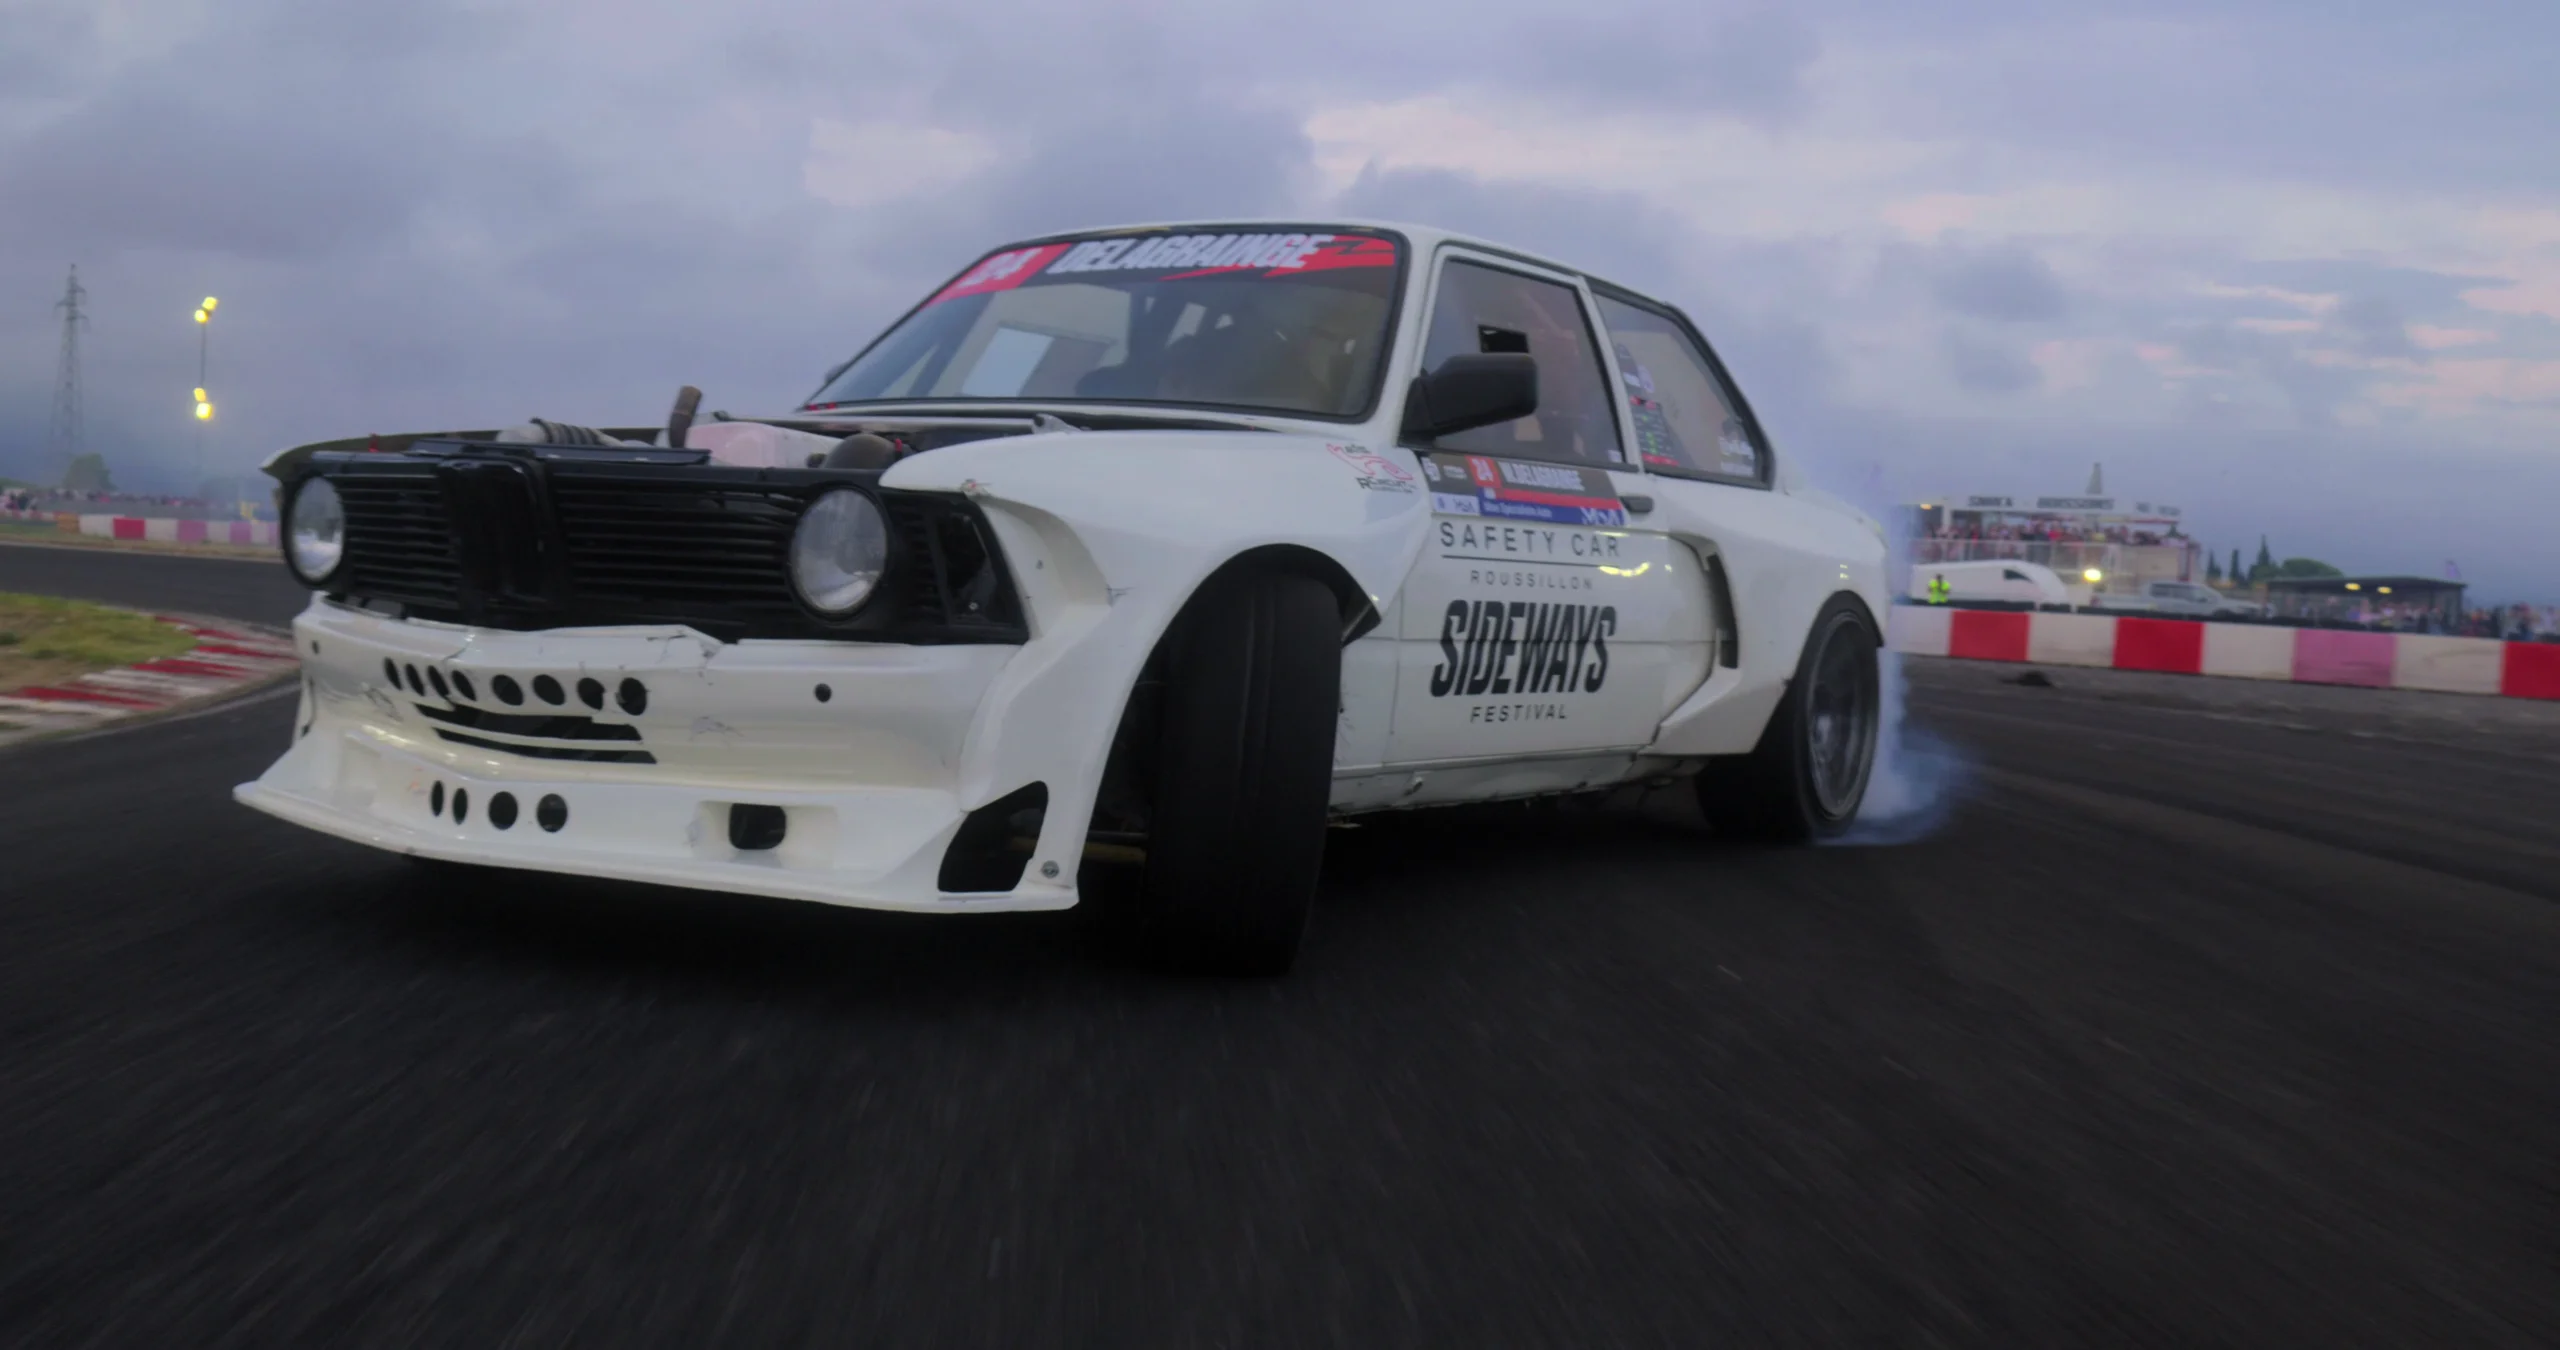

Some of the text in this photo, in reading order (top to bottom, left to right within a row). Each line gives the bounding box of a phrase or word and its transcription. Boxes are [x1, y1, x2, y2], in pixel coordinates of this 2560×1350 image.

[957, 247, 1044, 288] 24
[1471, 457, 1494, 483] 24
[1439, 521, 1621, 558] SAFETY CAR
[1470, 569, 1593, 591] ROUSSILLON
[1430, 599, 1617, 698] SIDEWAYS
[1470, 703, 1568, 724] FESTIVAL
